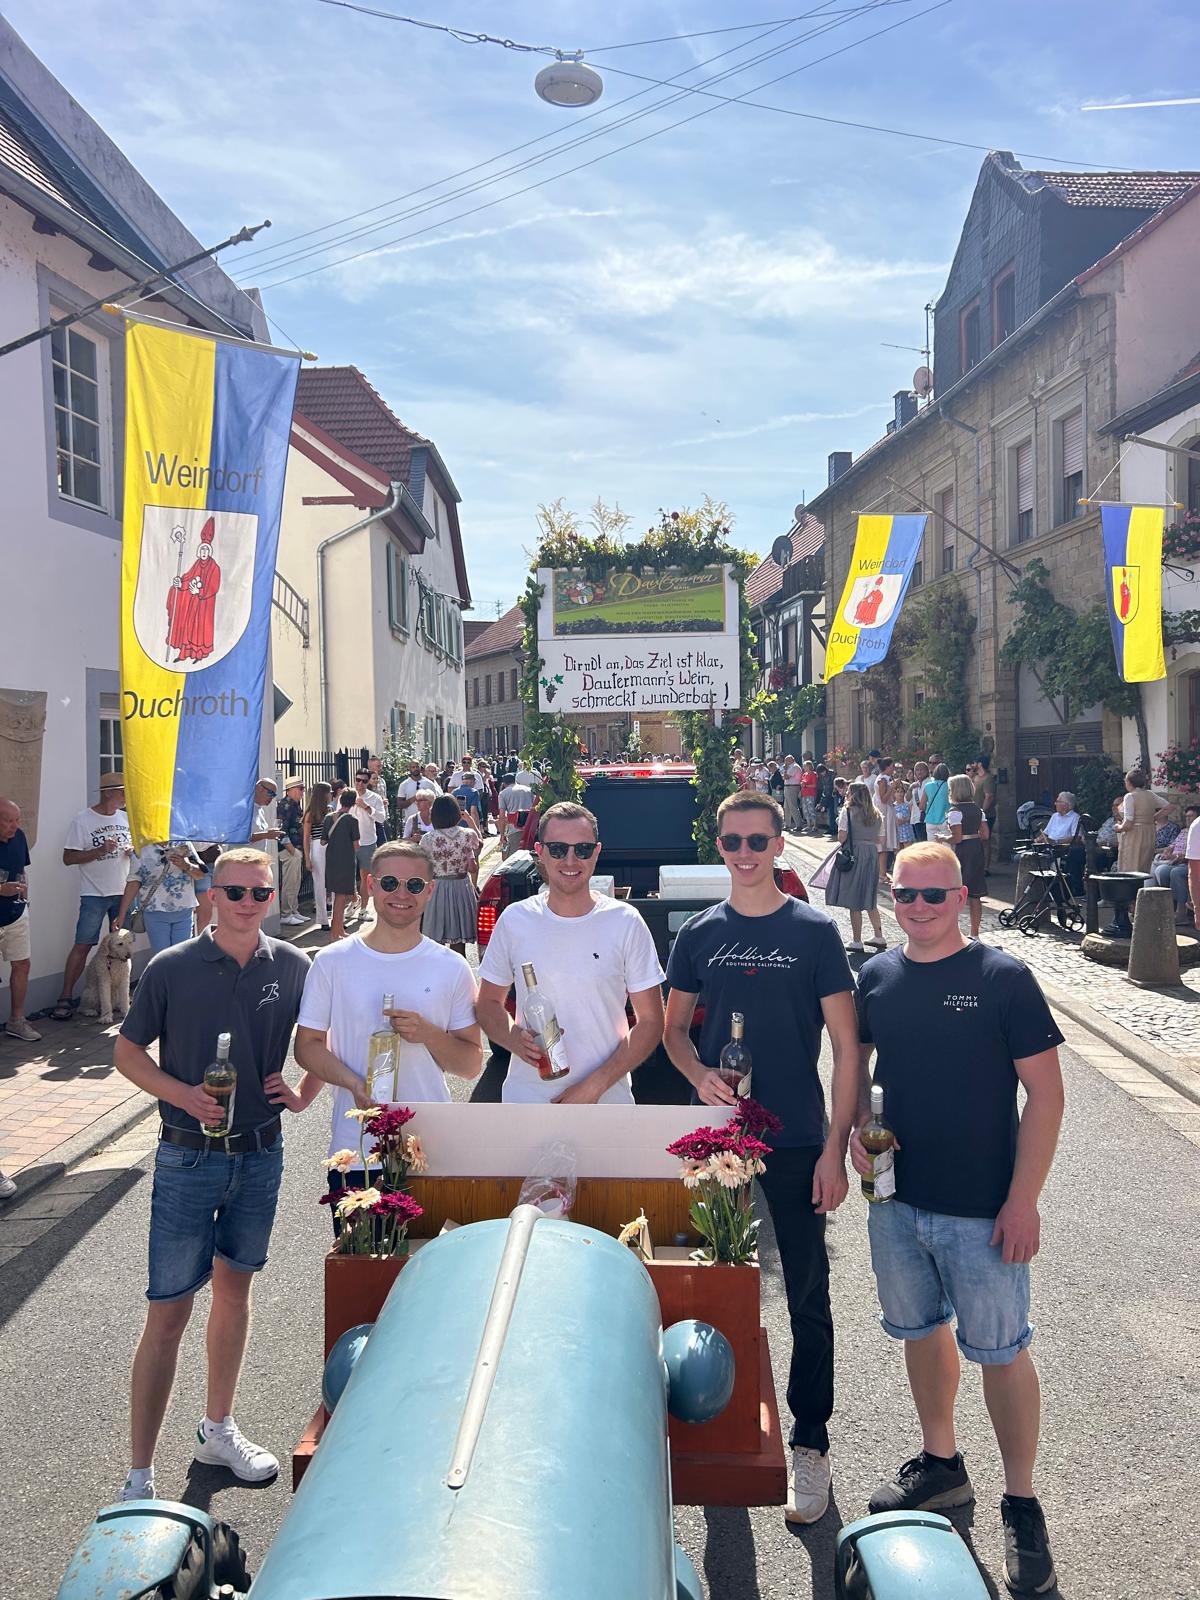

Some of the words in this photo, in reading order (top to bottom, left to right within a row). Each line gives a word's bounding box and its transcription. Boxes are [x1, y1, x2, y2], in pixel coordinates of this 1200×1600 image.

[145, 451, 263, 495] Weindorf
[859, 558, 908, 570] Weindorf
[831, 633, 886, 649] Duchroth
[647, 652, 672, 669] Ziel
[676, 652, 693, 669] ist
[582, 671, 674, 691] Dautermann's
[679, 670, 714, 686] Wein,
[125, 688, 249, 720] Duchroth
[572, 691, 637, 709] schmeckt
[707, 942, 798, 967] Hollister
